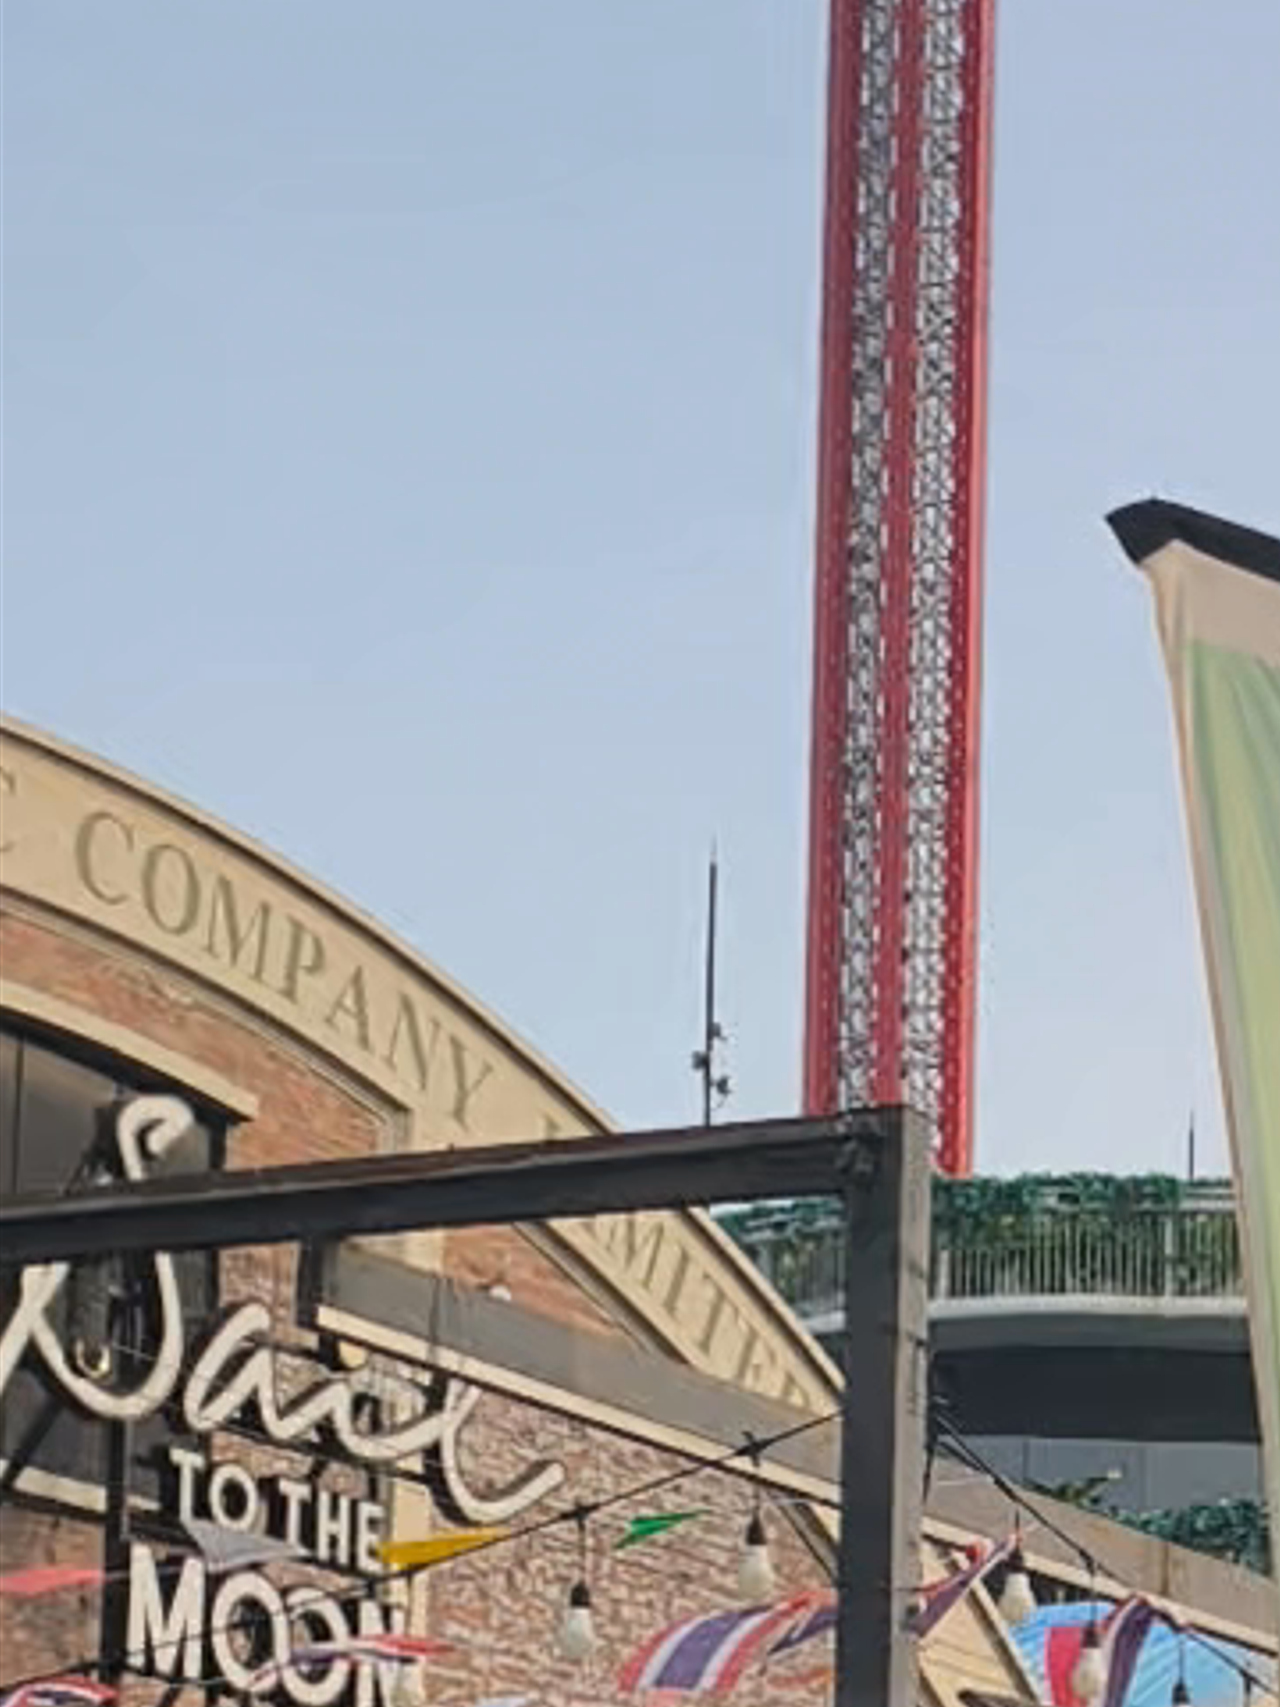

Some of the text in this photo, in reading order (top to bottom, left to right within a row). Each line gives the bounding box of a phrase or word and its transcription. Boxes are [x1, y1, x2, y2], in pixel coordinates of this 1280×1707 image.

[73, 810, 494, 1131] COMPANY
[169, 1447, 386, 1572] TO THE
